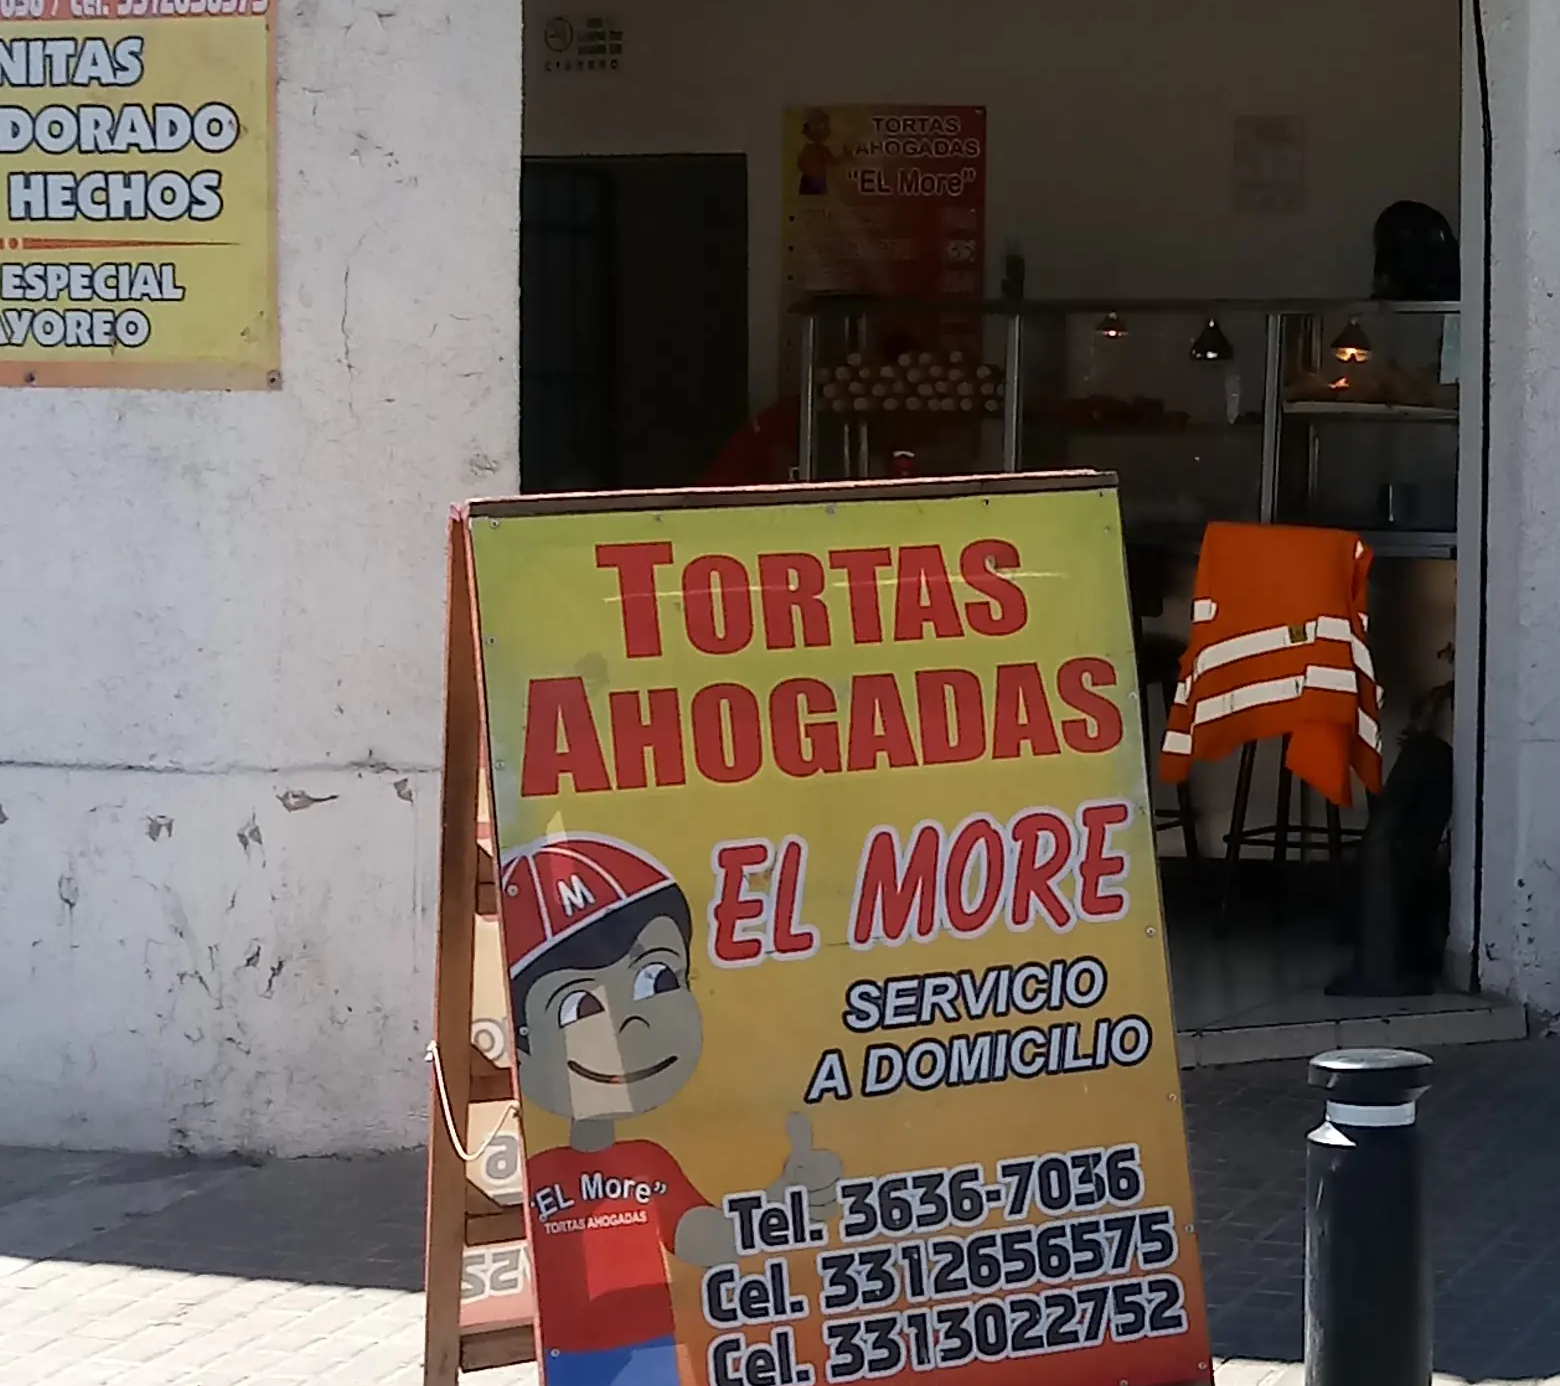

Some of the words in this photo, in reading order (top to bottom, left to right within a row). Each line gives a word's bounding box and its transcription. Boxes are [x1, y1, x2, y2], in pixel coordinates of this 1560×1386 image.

[0, 101, 240, 154] DORADO
[854, 136, 980, 158] AHOGADAS
[871, 115, 961, 135] TORTAS
[8, 169, 223, 222] HECHOS
[0, 262, 186, 301] ESPECIAL
[594, 539, 1029, 659] TORTAS
[519, 656, 1124, 798] AHOGADAS
[557, 872, 595, 916] M
[710, 837, 817, 967] EL
[850, 802, 1131, 947] MORE
[843, 956, 1109, 1032] SERVICIO
[805, 1049, 854, 1104] A
[862, 1015, 1153, 1096] DOMICILIO
[544, 1217, 586, 1234] TORTAS
[587, 1209, 649, 1229] AHOGADAS
[726, 1190, 824, 1252] Tel.
[839, 1145, 1143, 1241] 3636-7036
[702, 1265, 807, 1328] Cel.
[820, 1211, 1178, 1315] 3312656575
[825, 1274, 1186, 1384] 3313022752
